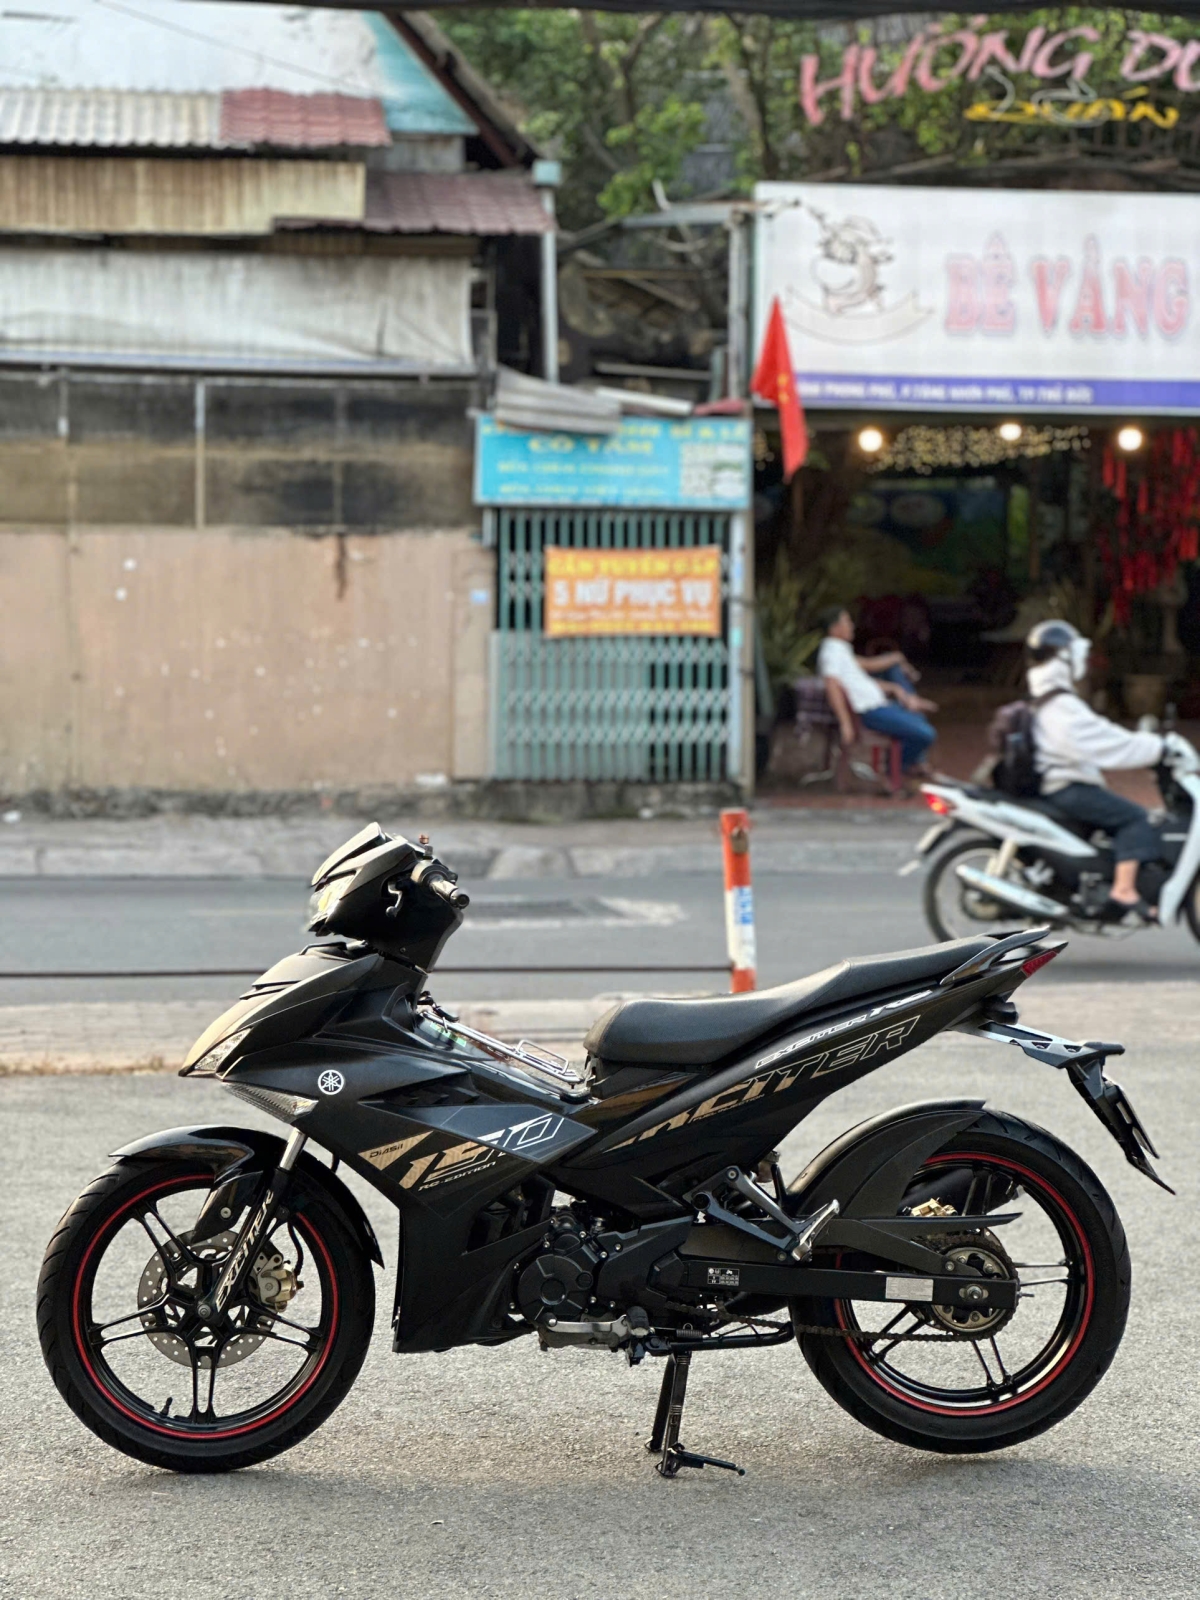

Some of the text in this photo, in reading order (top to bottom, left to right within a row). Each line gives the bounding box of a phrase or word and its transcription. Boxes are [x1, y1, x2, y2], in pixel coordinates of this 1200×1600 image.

[944, 230, 1016, 335] BÊ
[614, 579, 676, 608] PHỤC
[680, 579, 712, 607] VỤ
[755, 1013, 867, 1069] EXCITER
